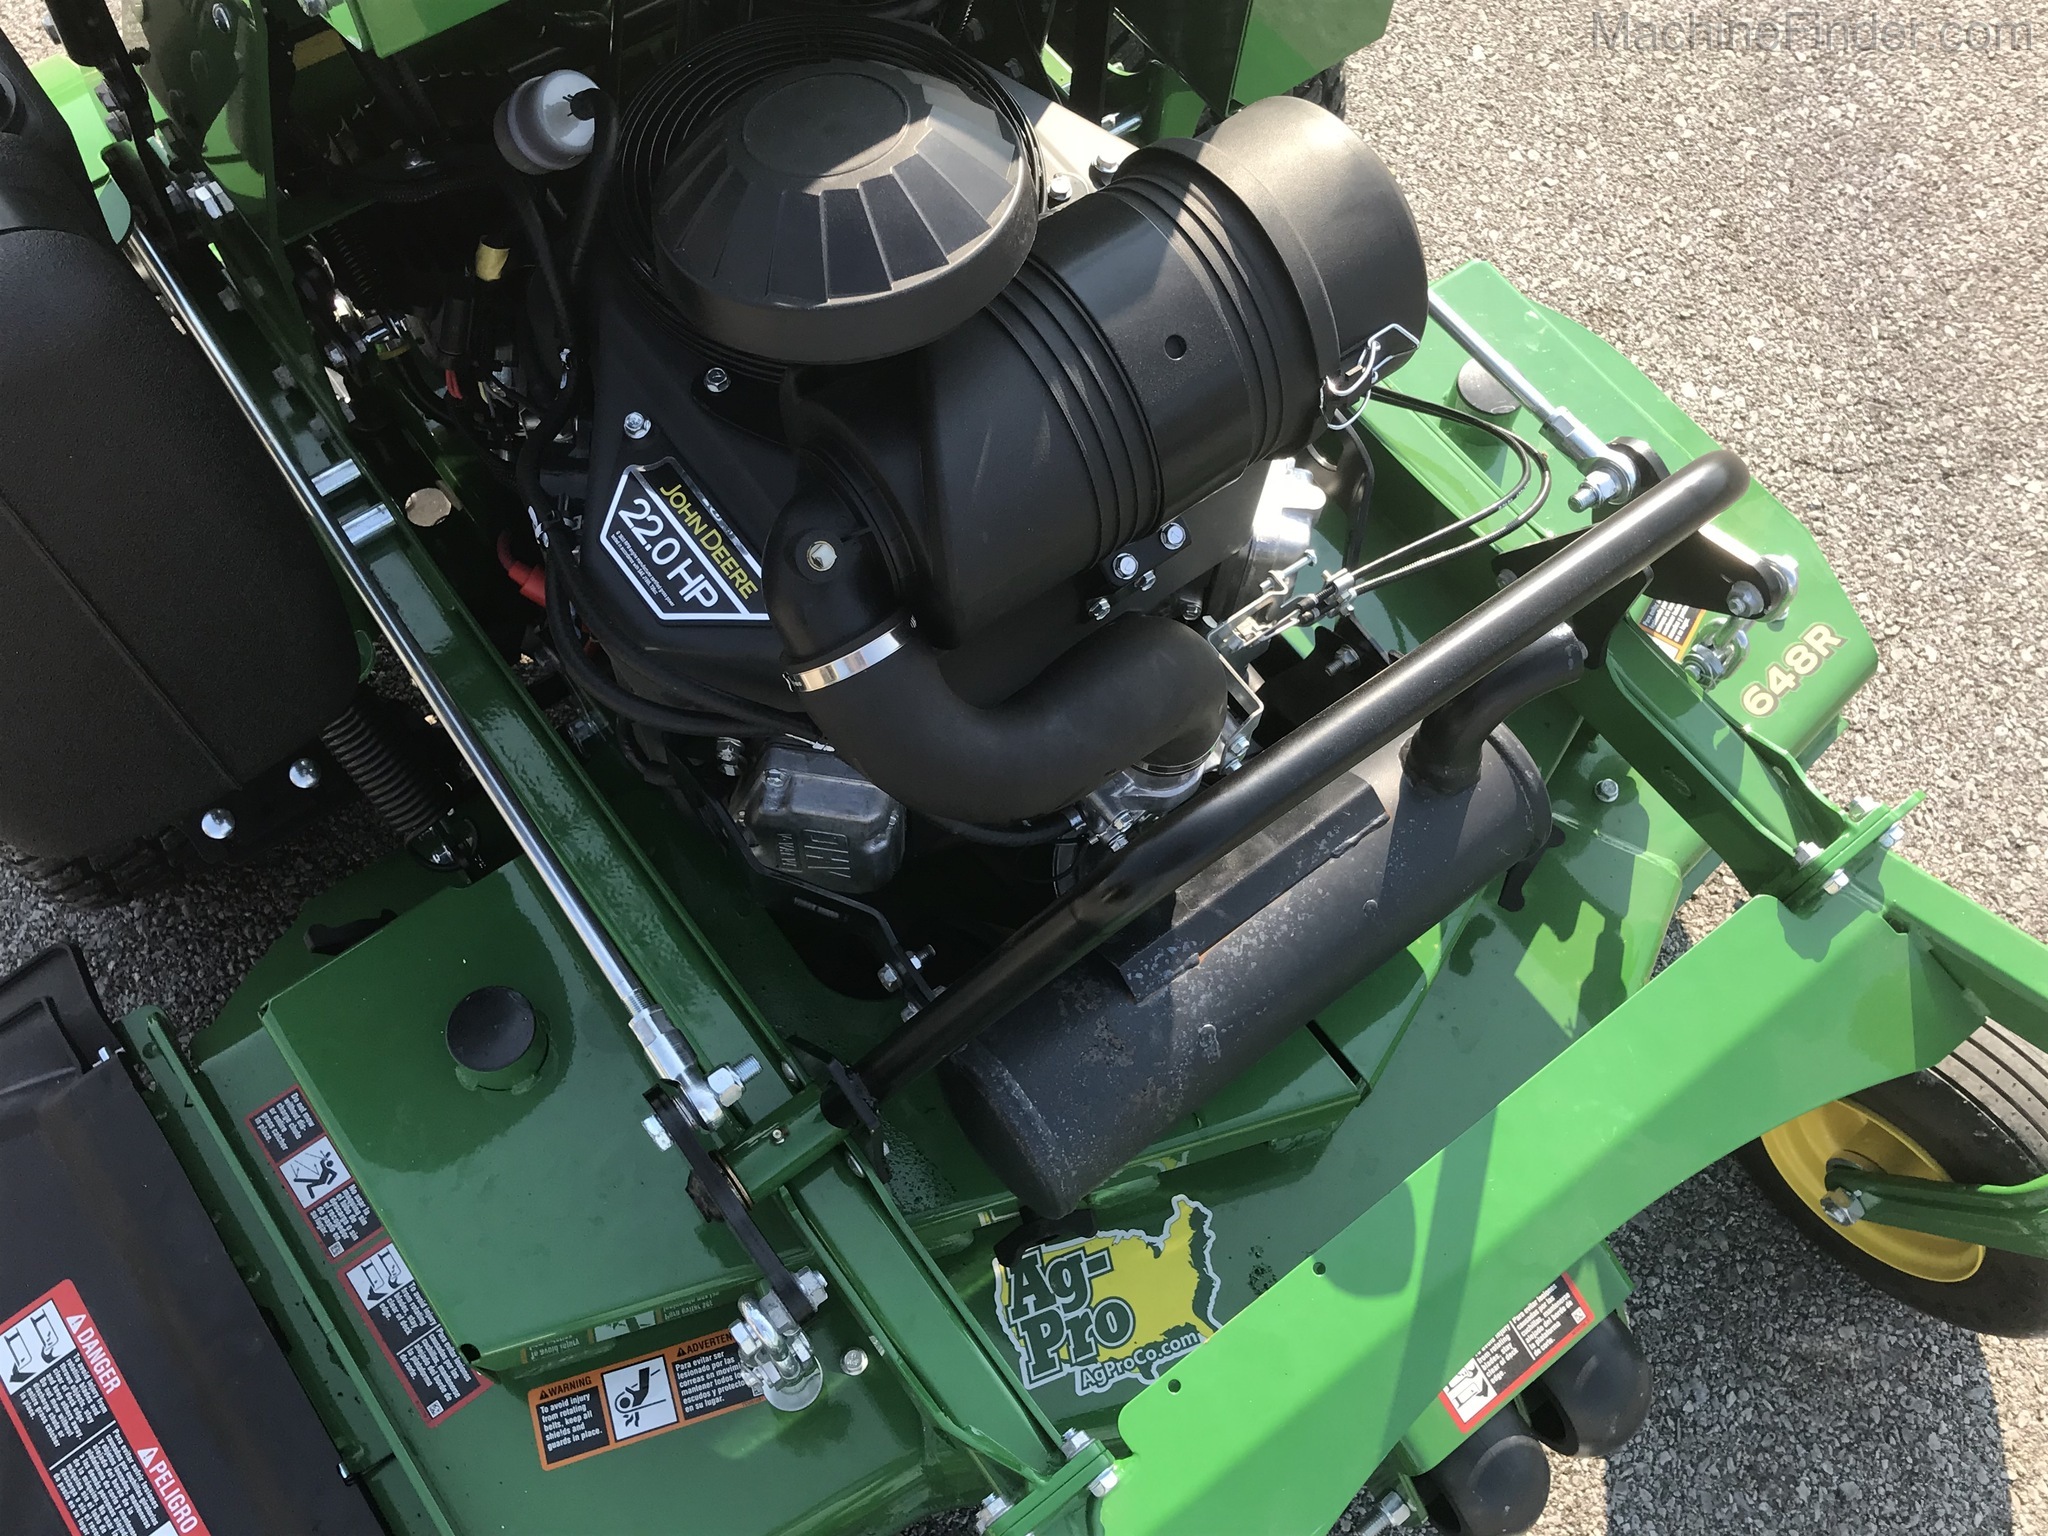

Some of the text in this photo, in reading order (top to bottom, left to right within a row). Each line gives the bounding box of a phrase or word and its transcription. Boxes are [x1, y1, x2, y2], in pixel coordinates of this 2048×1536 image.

[618, 499, 681, 565] 22.0
[667, 558, 719, 608] HP
[660, 484, 758, 600] JOHN DEERE
[1742, 624, 1845, 716] 648R
[1010, 1247, 1114, 1320] Ag-
[687, 1333, 733, 1353] ADVERTEN
[1020, 1297, 1135, 1384] Pro
[77, 1327, 121, 1394] DANGER
[675, 1351, 724, 1371] Para evitar ser
[677, 1356, 735, 1380] lesionado por las
[1082, 1332, 1199, 1388] AgProCo.com
[548, 1376, 592, 1397] WARNING
[679, 1375, 705, 1388] correas
[715, 1362, 741, 1376] movimi
[681, 1371, 742, 1396] mantener todos lo
[540, 1393, 590, 1414] To avoid injury
[683, 1378, 745, 1404] escudos y protecto
[541, 1404, 587, 1423] from rotating
[684, 1395, 725, 1413] en su lugar.
[564, 1414, 582, 1425] keep
[583, 1410, 593, 1420] all
[545, 1421, 585, 1441] shields and
[547, 1428, 603, 1451] guards in place.
[149, 1461, 198, 1534] PELIGRO
